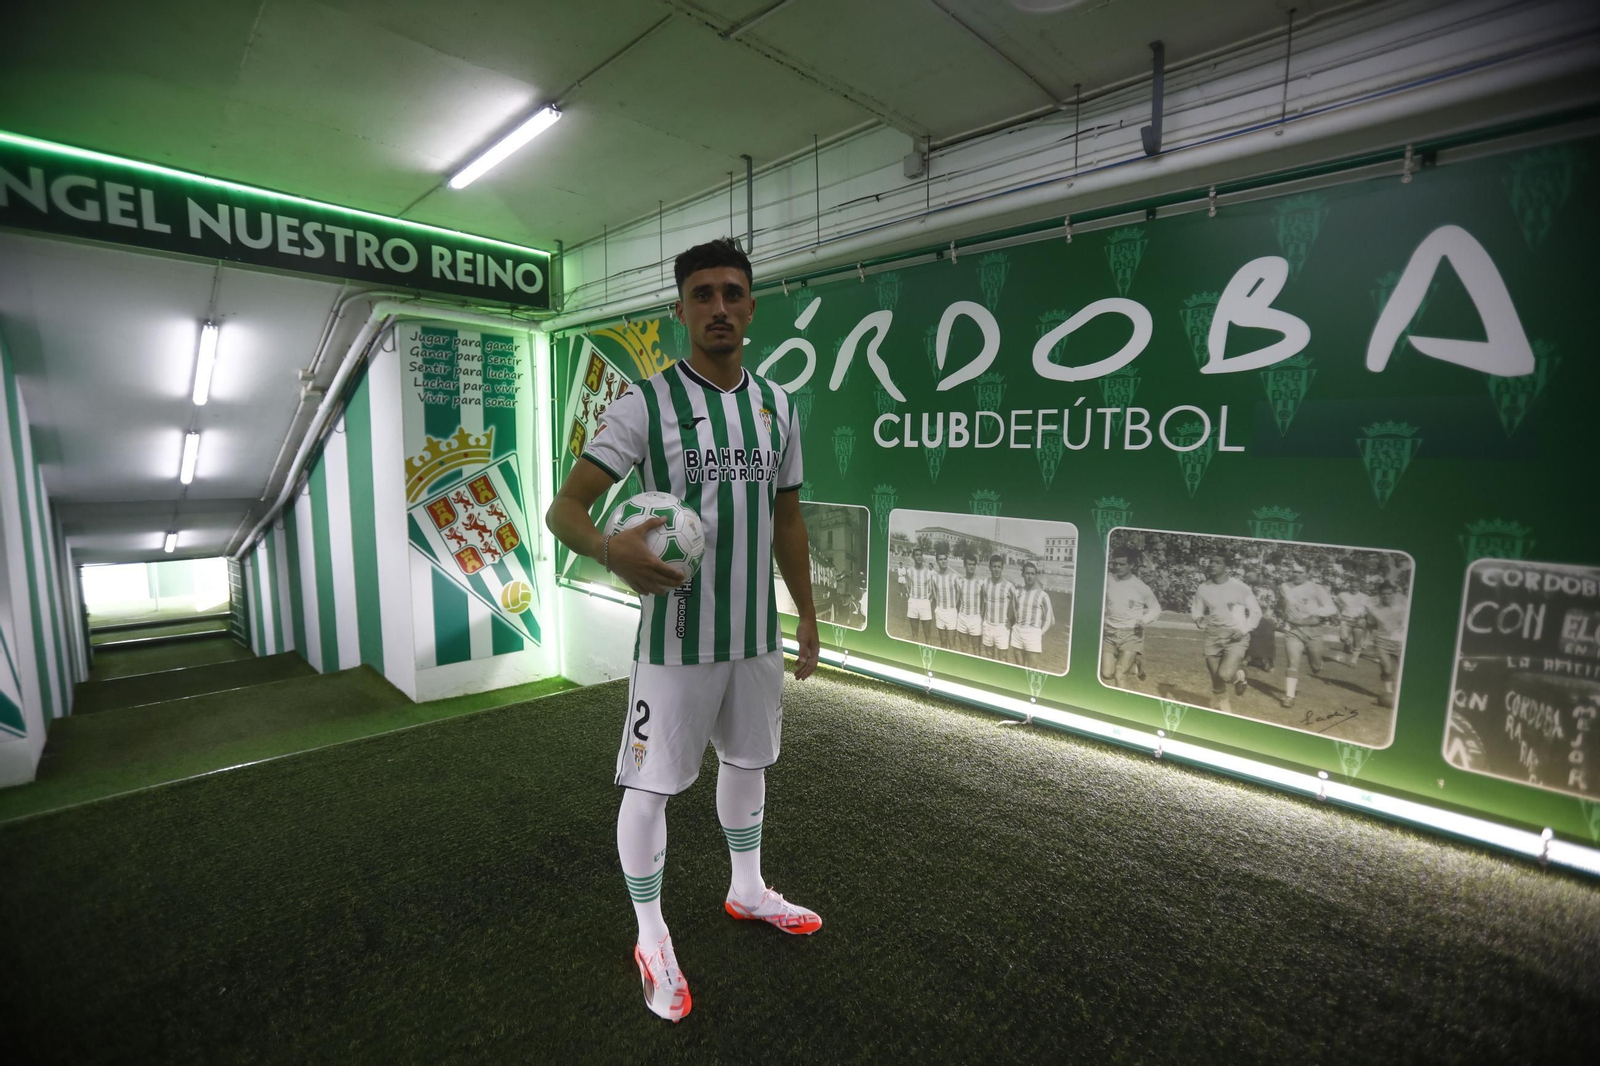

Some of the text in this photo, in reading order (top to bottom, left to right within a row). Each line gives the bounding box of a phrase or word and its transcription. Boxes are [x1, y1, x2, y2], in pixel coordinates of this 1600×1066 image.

[186, 197, 419, 273] NUESTRO
[431, 244, 544, 294] REINO
[743, 225, 1536, 403] ÓRDOBA
[410, 331, 521, 352] Jugar para ganar
[409, 346, 522, 366] Ganar para sentir
[409, 361, 523, 380] Sentir para luchar
[413, 377, 521, 394] Luchar para vivir
[418, 392, 518, 409] Vivir para soñar
[685, 448, 780, 469] BAHRAIN
[1481, 568, 1600, 597] CORDOB
[677, 597, 686, 638] CÓRDOBA
[633, 699, 650, 742] 2
